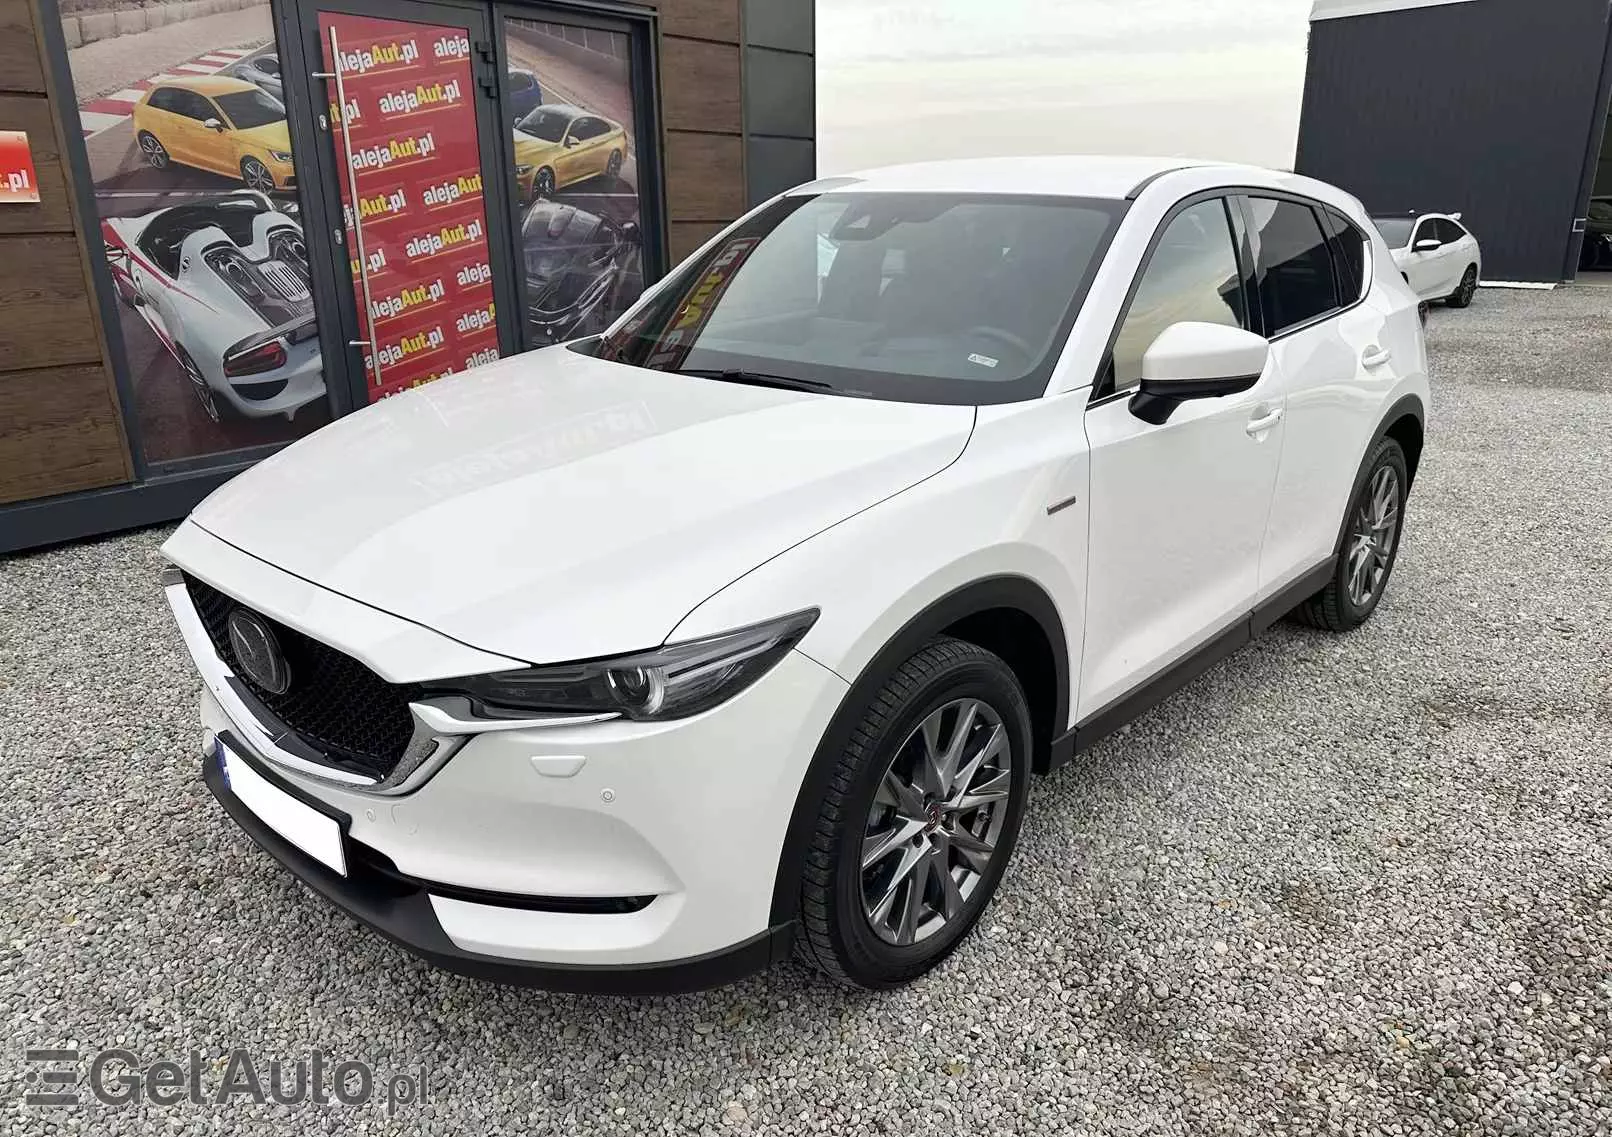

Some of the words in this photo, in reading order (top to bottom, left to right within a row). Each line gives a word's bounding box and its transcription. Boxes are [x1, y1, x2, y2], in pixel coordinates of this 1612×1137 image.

[379, 79, 461, 114] alejaAut.pl
[352, 133, 435, 169] alejaAut.pl
[0, 169, 29, 192] .pl
[406, 219, 482, 257] alejaAut.pl
[364, 326, 444, 369] aejaAut.pl
